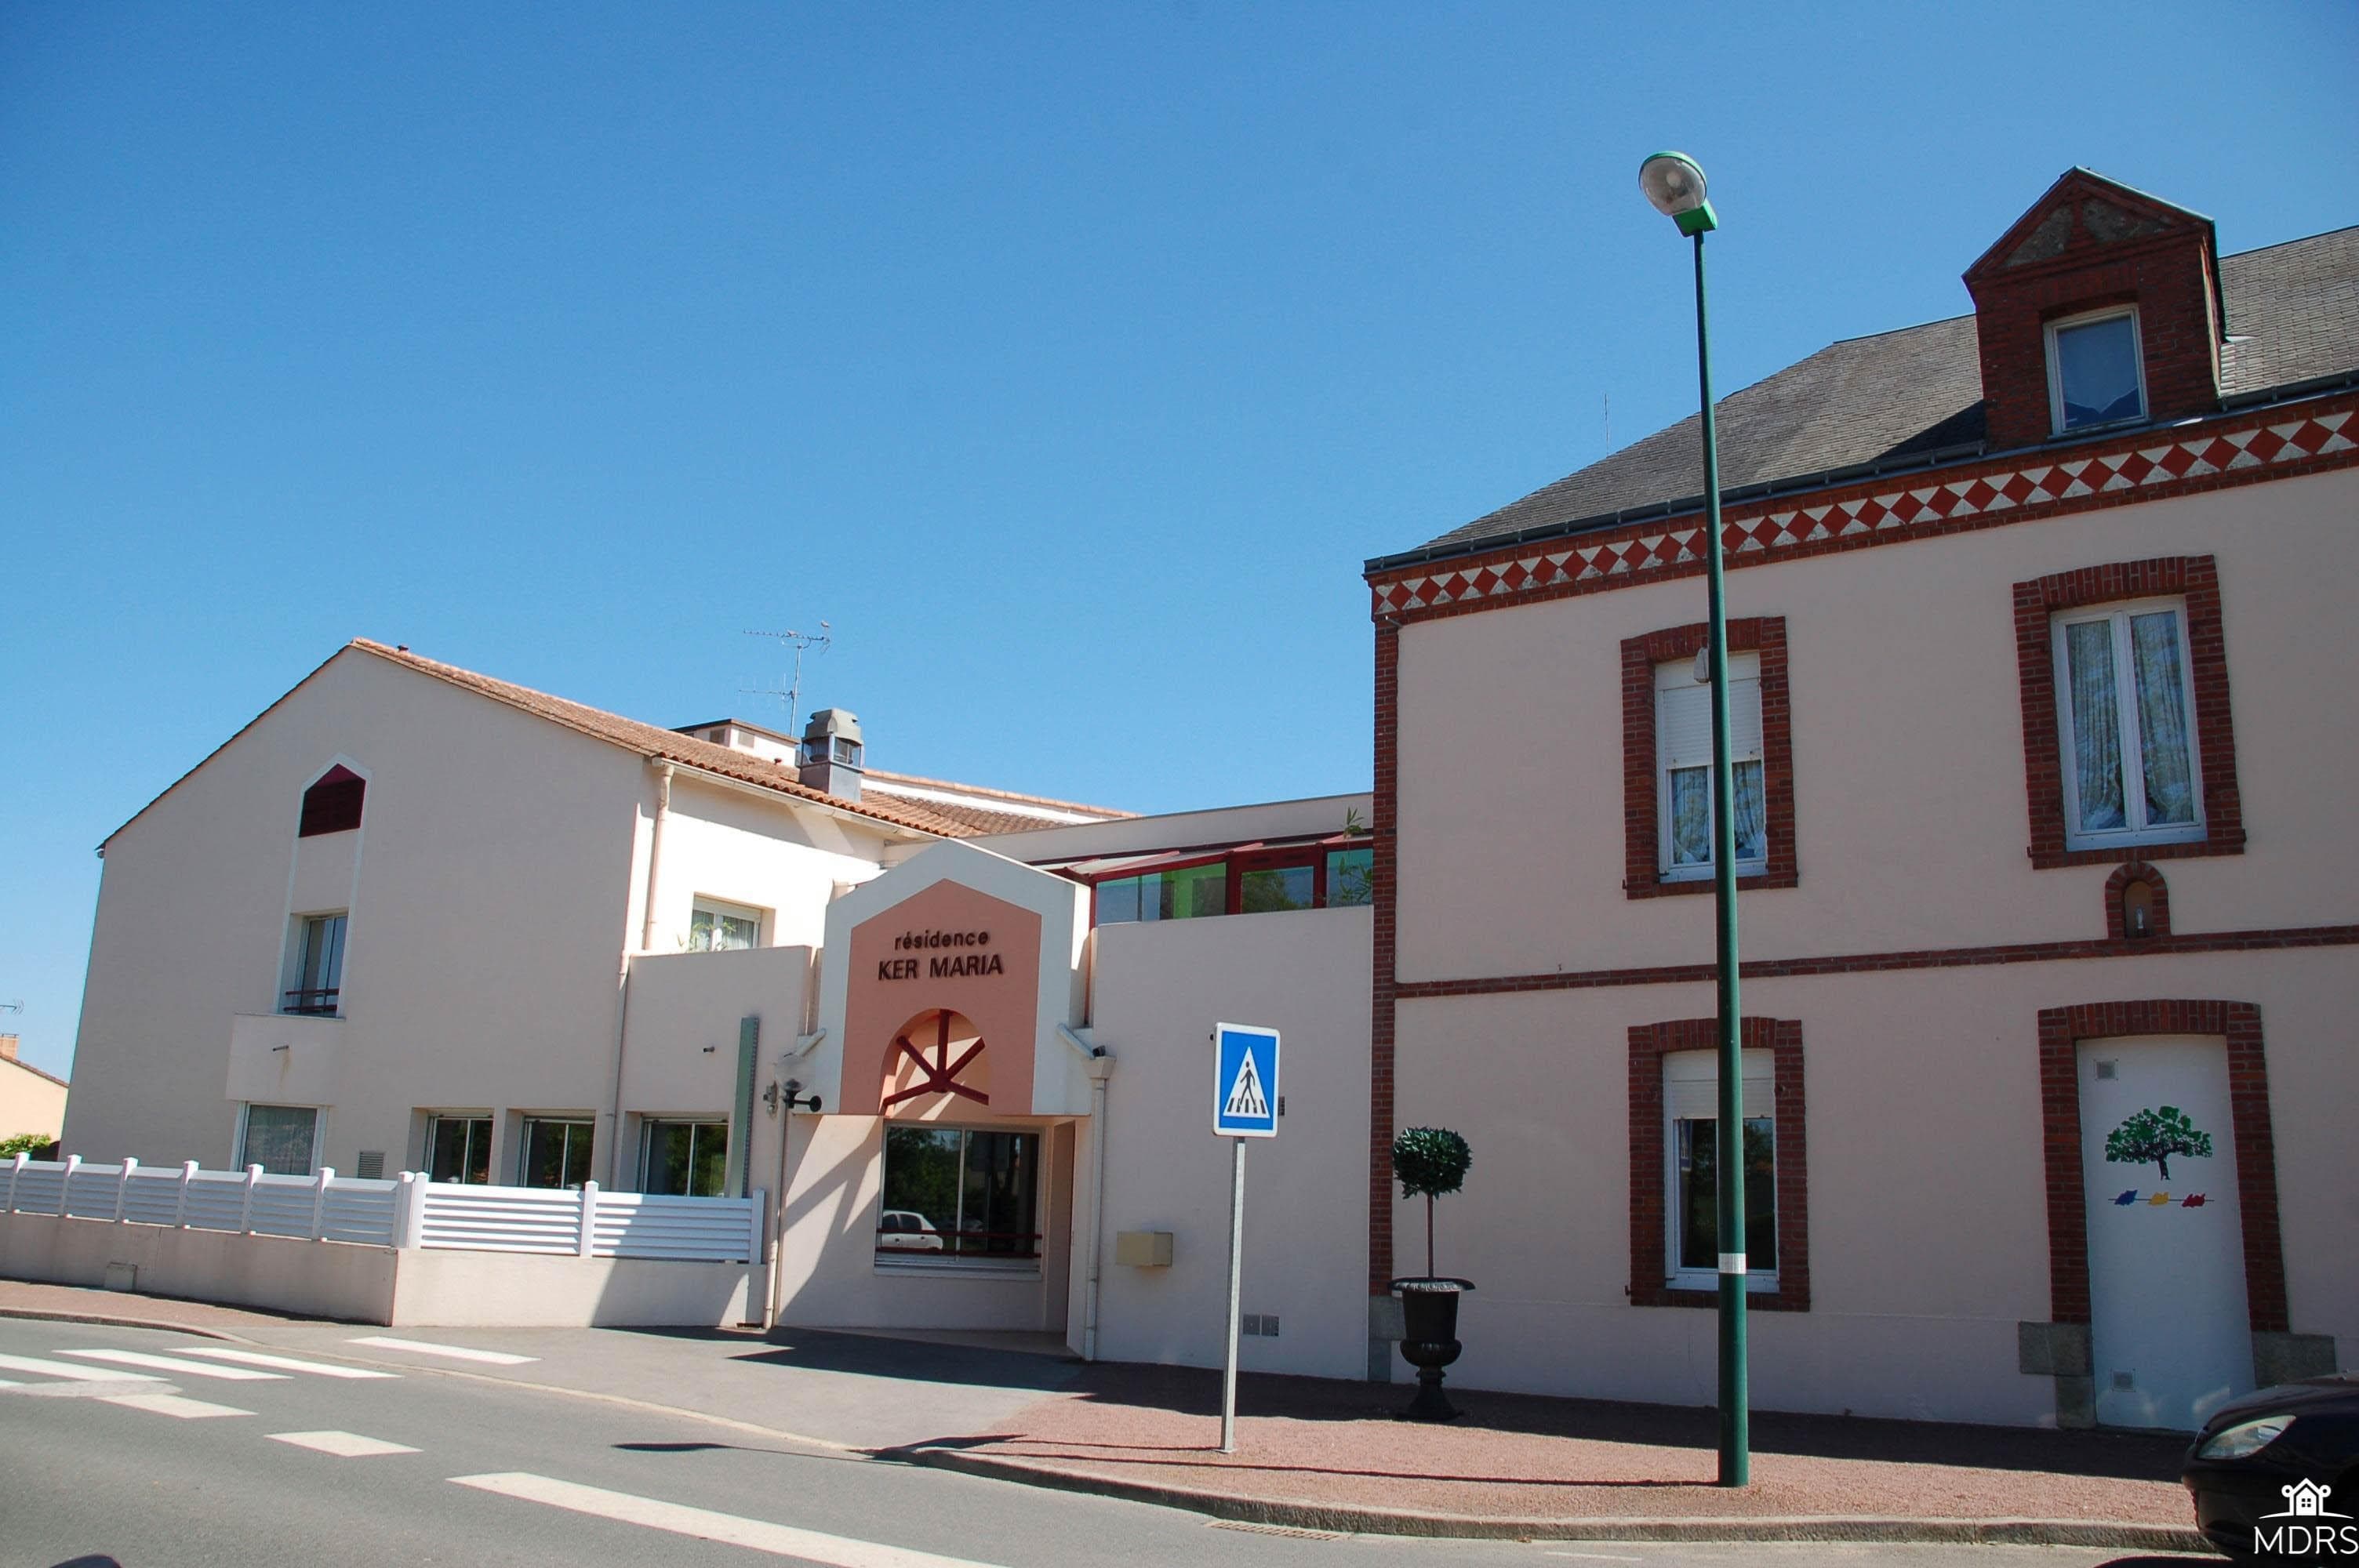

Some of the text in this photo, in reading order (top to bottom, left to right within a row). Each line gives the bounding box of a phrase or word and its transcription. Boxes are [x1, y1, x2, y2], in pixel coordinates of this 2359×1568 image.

[895, 930, 990, 950] résidence
[878, 953, 1004, 981] KER MARIA
